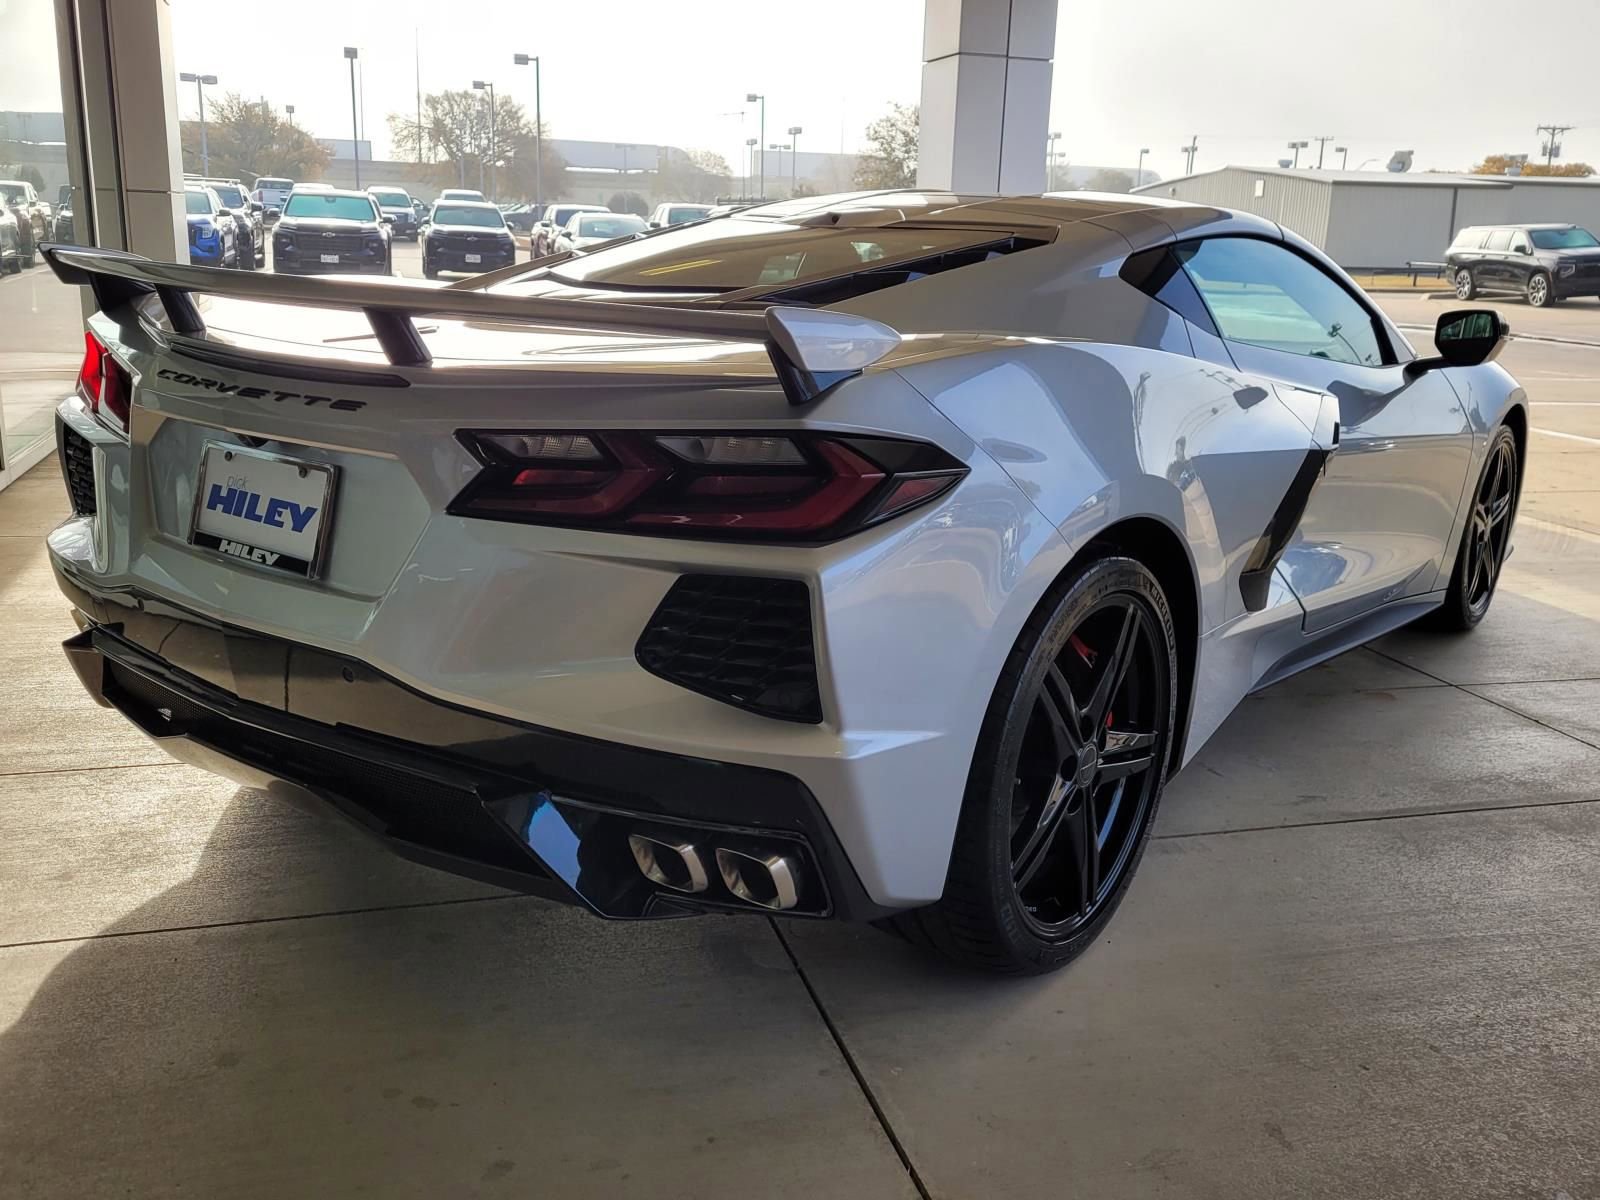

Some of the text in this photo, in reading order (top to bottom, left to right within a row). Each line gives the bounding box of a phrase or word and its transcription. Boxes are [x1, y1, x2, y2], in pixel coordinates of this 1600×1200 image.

[156, 368, 367, 411] CORVETTE
[206, 483, 318, 533] HILEY
[219, 540, 280, 566] HILEY
